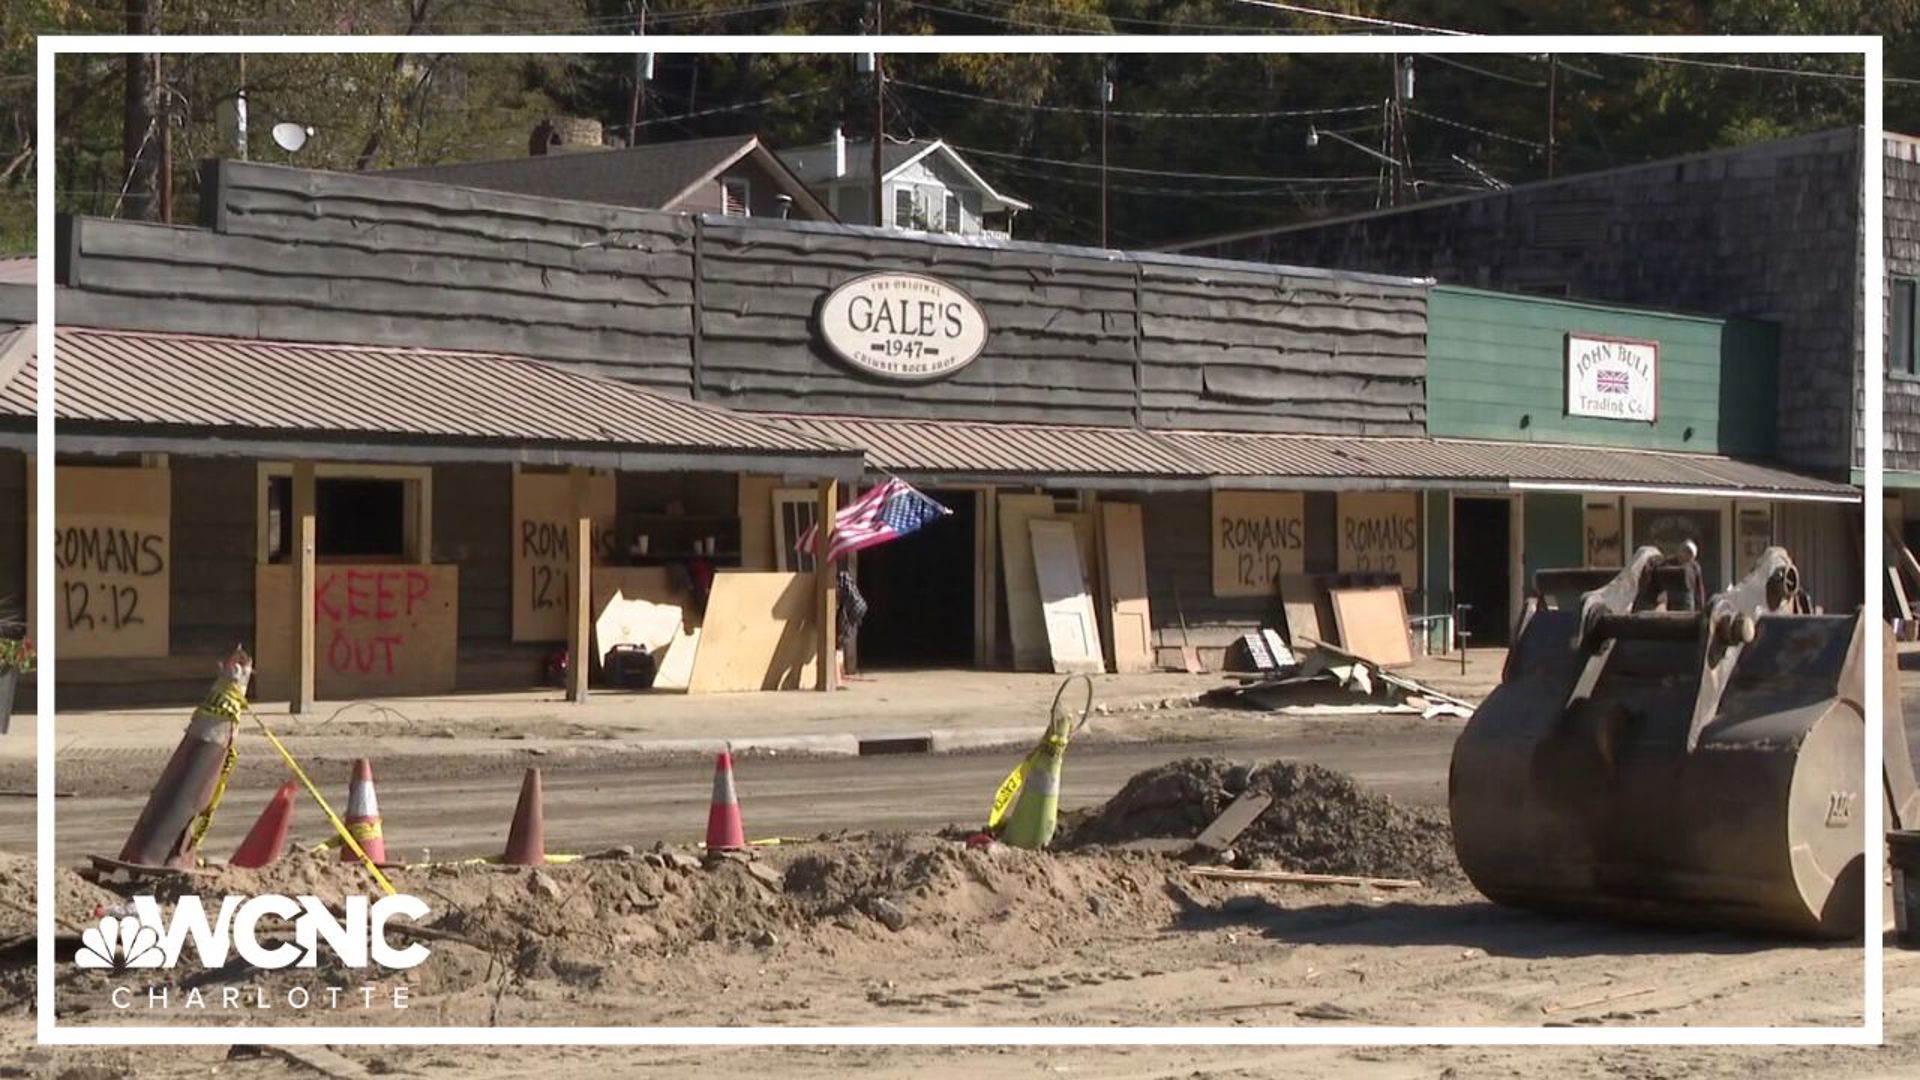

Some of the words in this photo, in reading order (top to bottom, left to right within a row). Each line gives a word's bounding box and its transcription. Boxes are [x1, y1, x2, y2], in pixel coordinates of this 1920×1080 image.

[871, 281, 890, 293] THE
[848, 295, 962, 338] GALE'S
[854, 350, 898, 372] CHIMNEY
[901, 361, 927, 373] ROCK
[931, 357, 957, 370] SHOP
[1576, 344, 1611, 378] JOHN
[1618, 346, 1648, 381] BULL
[1579, 396, 1624, 414] Trading
[1221, 514, 1302, 551] ROMANS
[1344, 513, 1416, 552] ROMANS
[1238, 553, 1281, 586] 12:12
[62, 580, 145, 631] 12:12
[315, 569, 431, 623] KEEP
[328, 632, 406, 678] OUT
